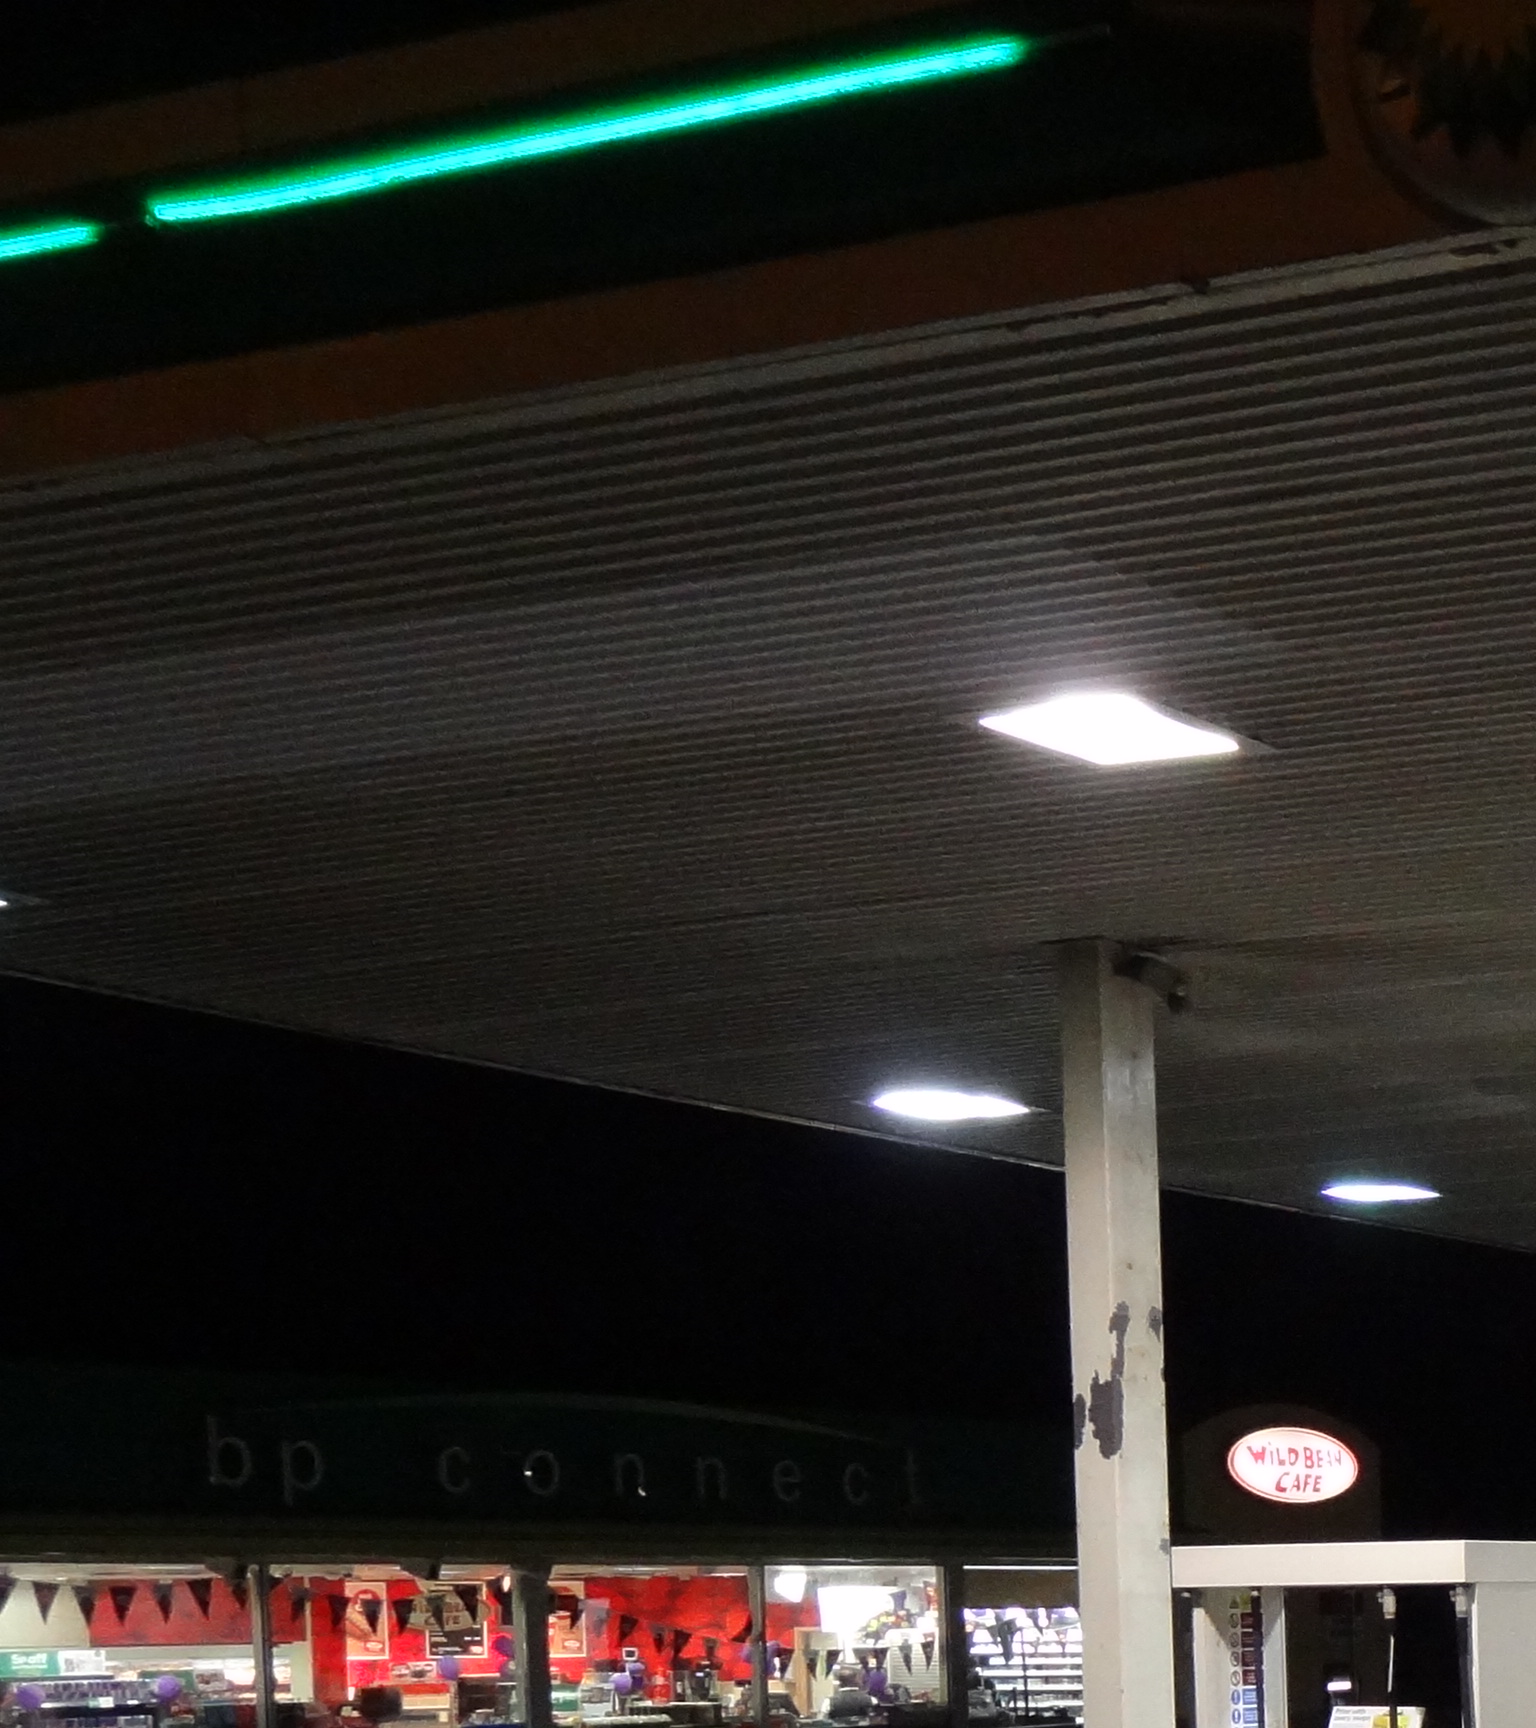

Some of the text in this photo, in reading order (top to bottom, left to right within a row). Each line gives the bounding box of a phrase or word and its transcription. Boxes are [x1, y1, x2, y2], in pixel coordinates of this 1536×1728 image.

[205, 1414, 924, 1507] bp connect
[1275, 1472, 1322, 1493] CAFE
